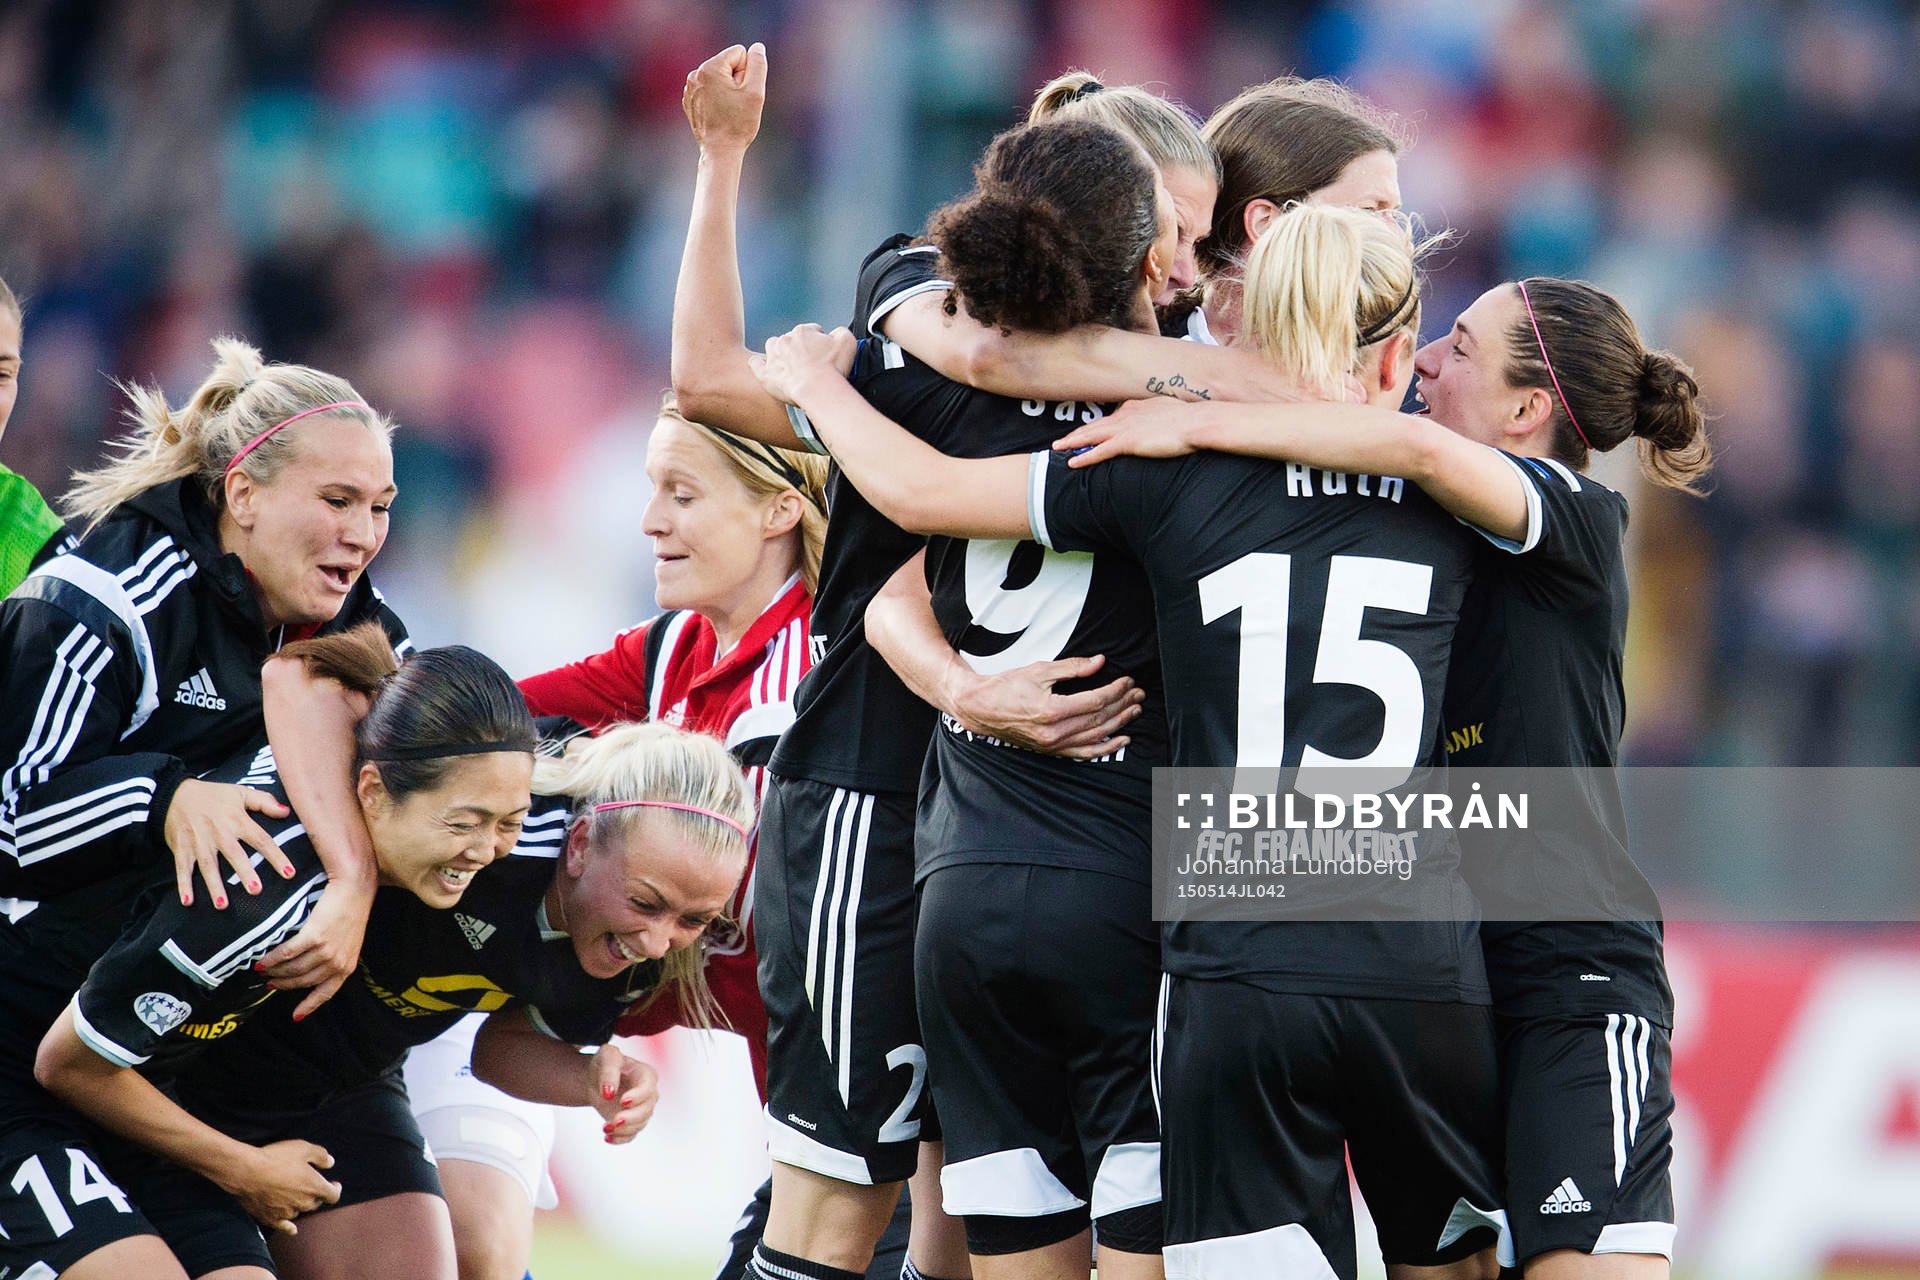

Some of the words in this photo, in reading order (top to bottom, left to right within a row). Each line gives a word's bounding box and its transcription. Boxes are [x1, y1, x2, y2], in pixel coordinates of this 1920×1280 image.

[959, 539, 1094, 675] 9
[174, 690, 226, 711] adidas
[1198, 552, 1433, 806] 15
[1254, 828, 1418, 863] FRANKFURT
[10, 1147, 133, 1238] 14
[1540, 1200, 1592, 1215] adidas
